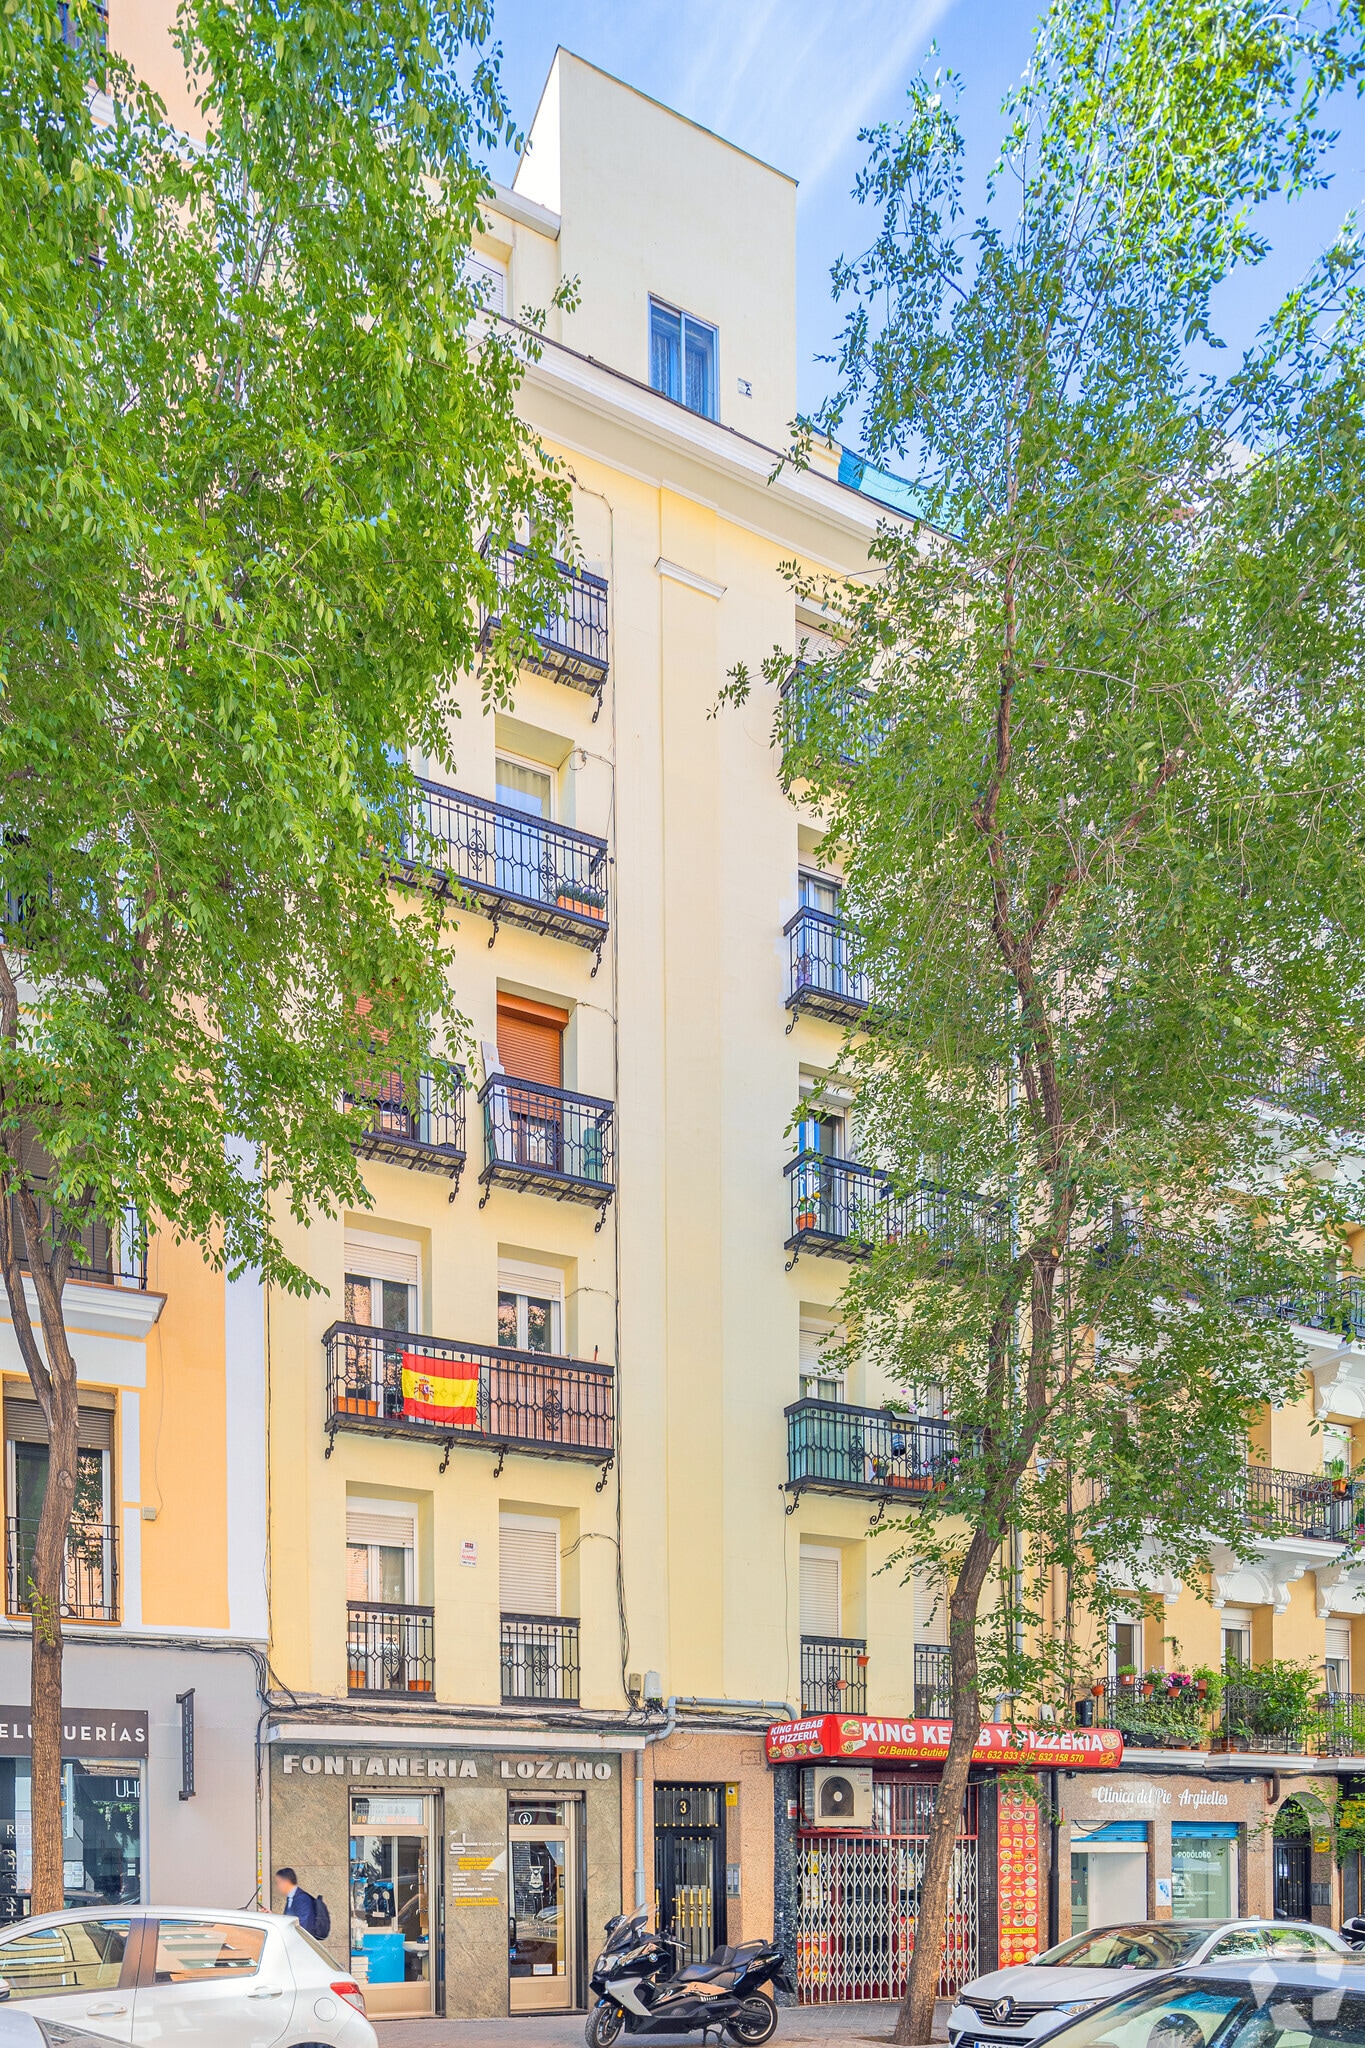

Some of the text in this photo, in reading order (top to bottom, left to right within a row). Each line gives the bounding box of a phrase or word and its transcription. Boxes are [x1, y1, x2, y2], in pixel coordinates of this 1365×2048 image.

[0, 1723, 146, 1742] ELUERÍAS
[770, 1719, 823, 1736] KING KEBAB
[862, 1722, 916, 1744] KING
[922, 1725, 991, 1747] KEB
[996, 1729, 1010, 1747] Y
[771, 1730, 818, 1745] Y PIZZERIA
[878, 1746, 888, 1755] C/
[889, 1745, 918, 1756] Benito
[987, 1750, 1001, 1759] 632
[1003, 1751, 1017, 1760] 633
[1038, 1753, 1053, 1761] 632
[1055, 1753, 1068, 1762] 158
[1070, 1754, 1084, 1762] 570
[282, 1754, 612, 1780] FONTANERIA LOZANO
[1097, 1785, 1228, 1810] Clínica del Pie Argüelles
[679, 1801, 687, 1814] 3
